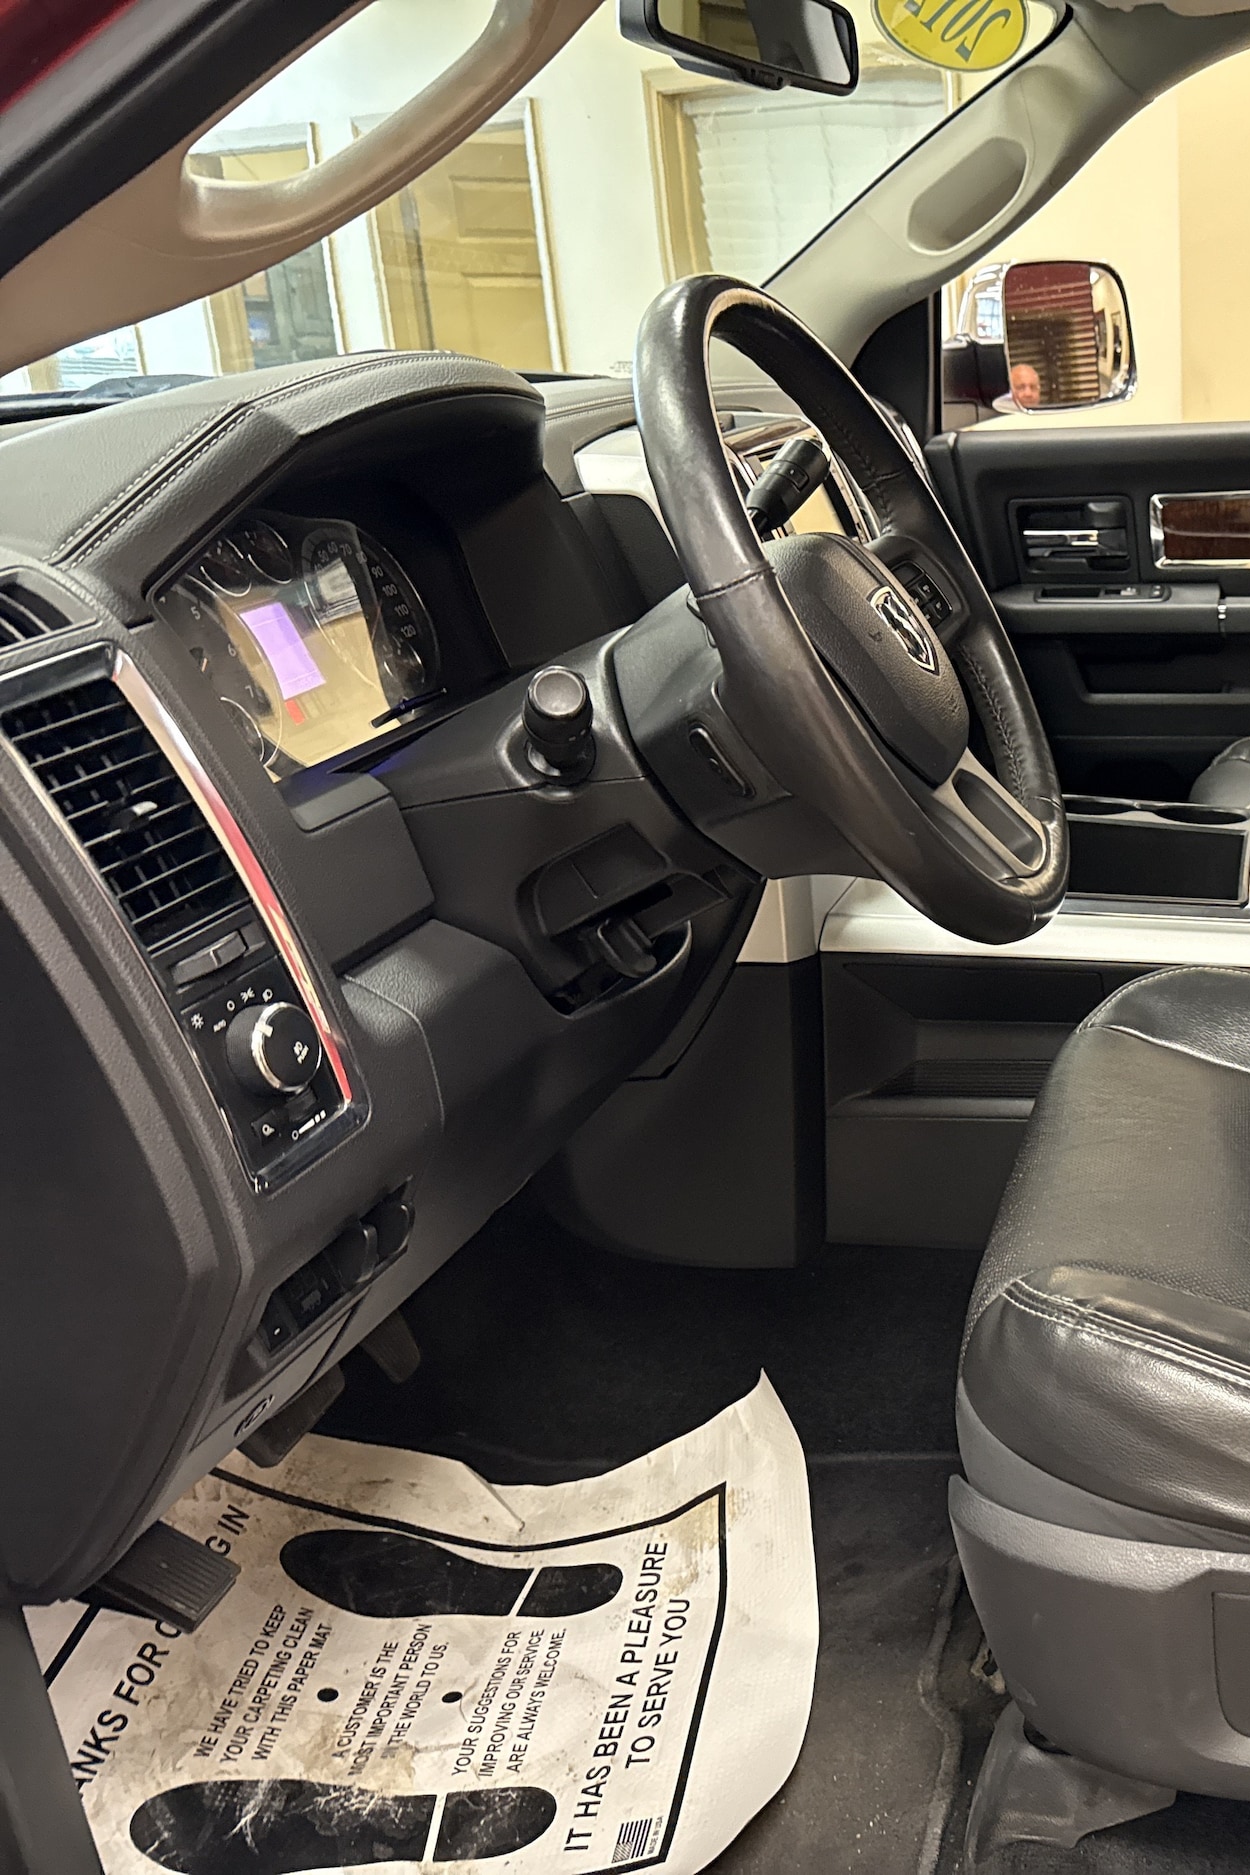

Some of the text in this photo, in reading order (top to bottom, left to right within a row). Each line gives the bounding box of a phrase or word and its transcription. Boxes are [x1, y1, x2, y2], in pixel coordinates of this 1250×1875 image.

[191, 606, 201, 621] 5
[371, 566, 384, 579] 90
[382, 584, 398, 597] 100
[394, 604, 409, 617] 110
[227, 644, 237, 657] 6
[400, 624, 416, 639] 120
[113, 1642, 170, 1705] FOR
[218, 1504, 250, 1535] IN
[430, 1641, 449, 1660] US.
[193, 1604, 286, 1758] WE HAVE TRIED TO KEEP
[220, 1607, 314, 1763] YOUR CARPETING CLEAN
[251, 1623, 332, 1760] WITH THIS PAPER MAT
[331, 1641, 399, 1758] A CUSTOMER IS THE
[347, 1623, 432, 1776] MOST IMPORTANT PERSON
[400, 1680, 431, 1721] WORLD
[421, 1661, 440, 1678] TO
[451, 1631, 522, 1777] YOUR SUGGESTIONS FOR
[478, 1628, 545, 1777] IMPROVING OUR SERVICE
[506, 1628, 567, 1773] ARE ALWAYS WELCOME.
[563, 1542, 668, 1852] IT HAS BEEN A PLEASURE
[624, 1598, 691, 1770] TO SERVE YOU
[387, 1721, 412, 1746] THE
